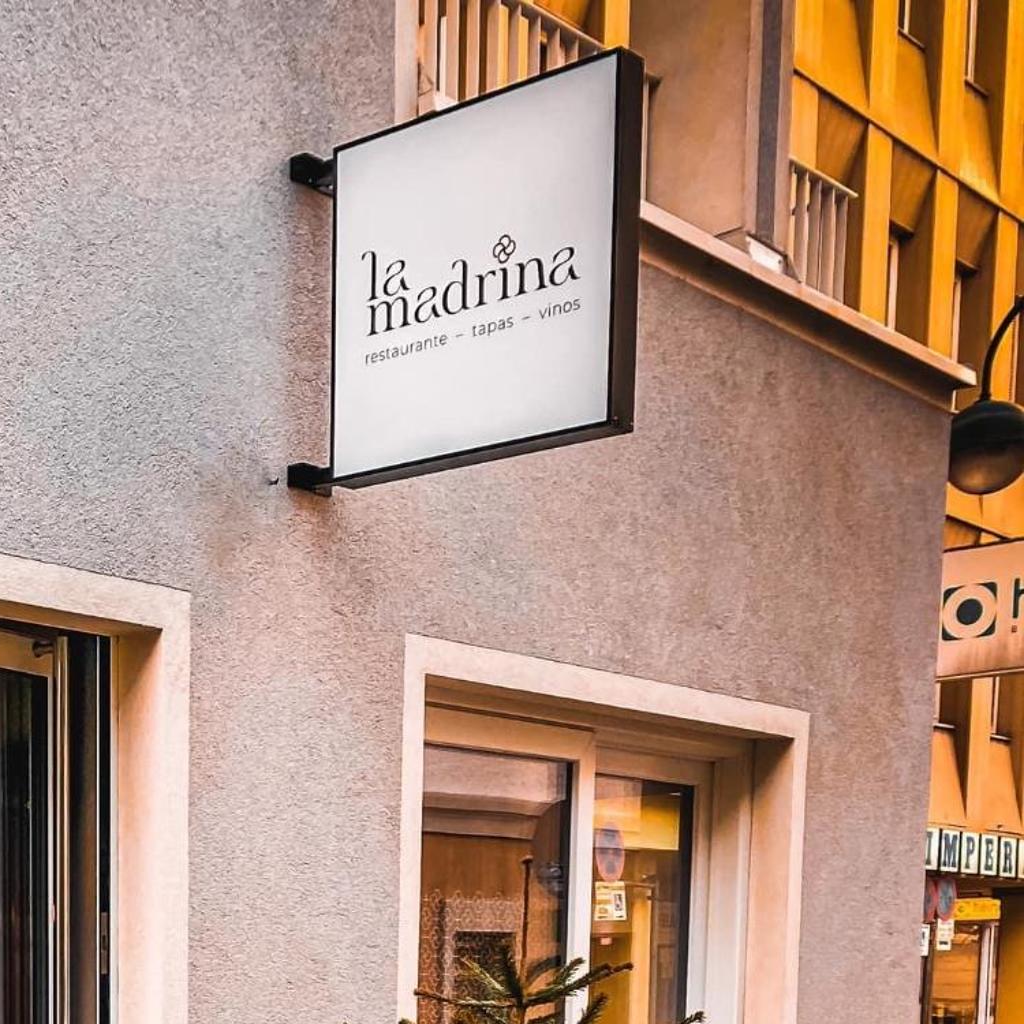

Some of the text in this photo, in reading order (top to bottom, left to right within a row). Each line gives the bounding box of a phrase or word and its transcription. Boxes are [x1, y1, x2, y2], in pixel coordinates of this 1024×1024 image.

[361, 250, 411, 301] la
[367, 236, 581, 336] madrina
[364, 332, 448, 366] restaurante
[472, 315, 514, 338] tapas
[538, 298, 581, 320] vinos
[925, 830, 1024, 875] IMPER
